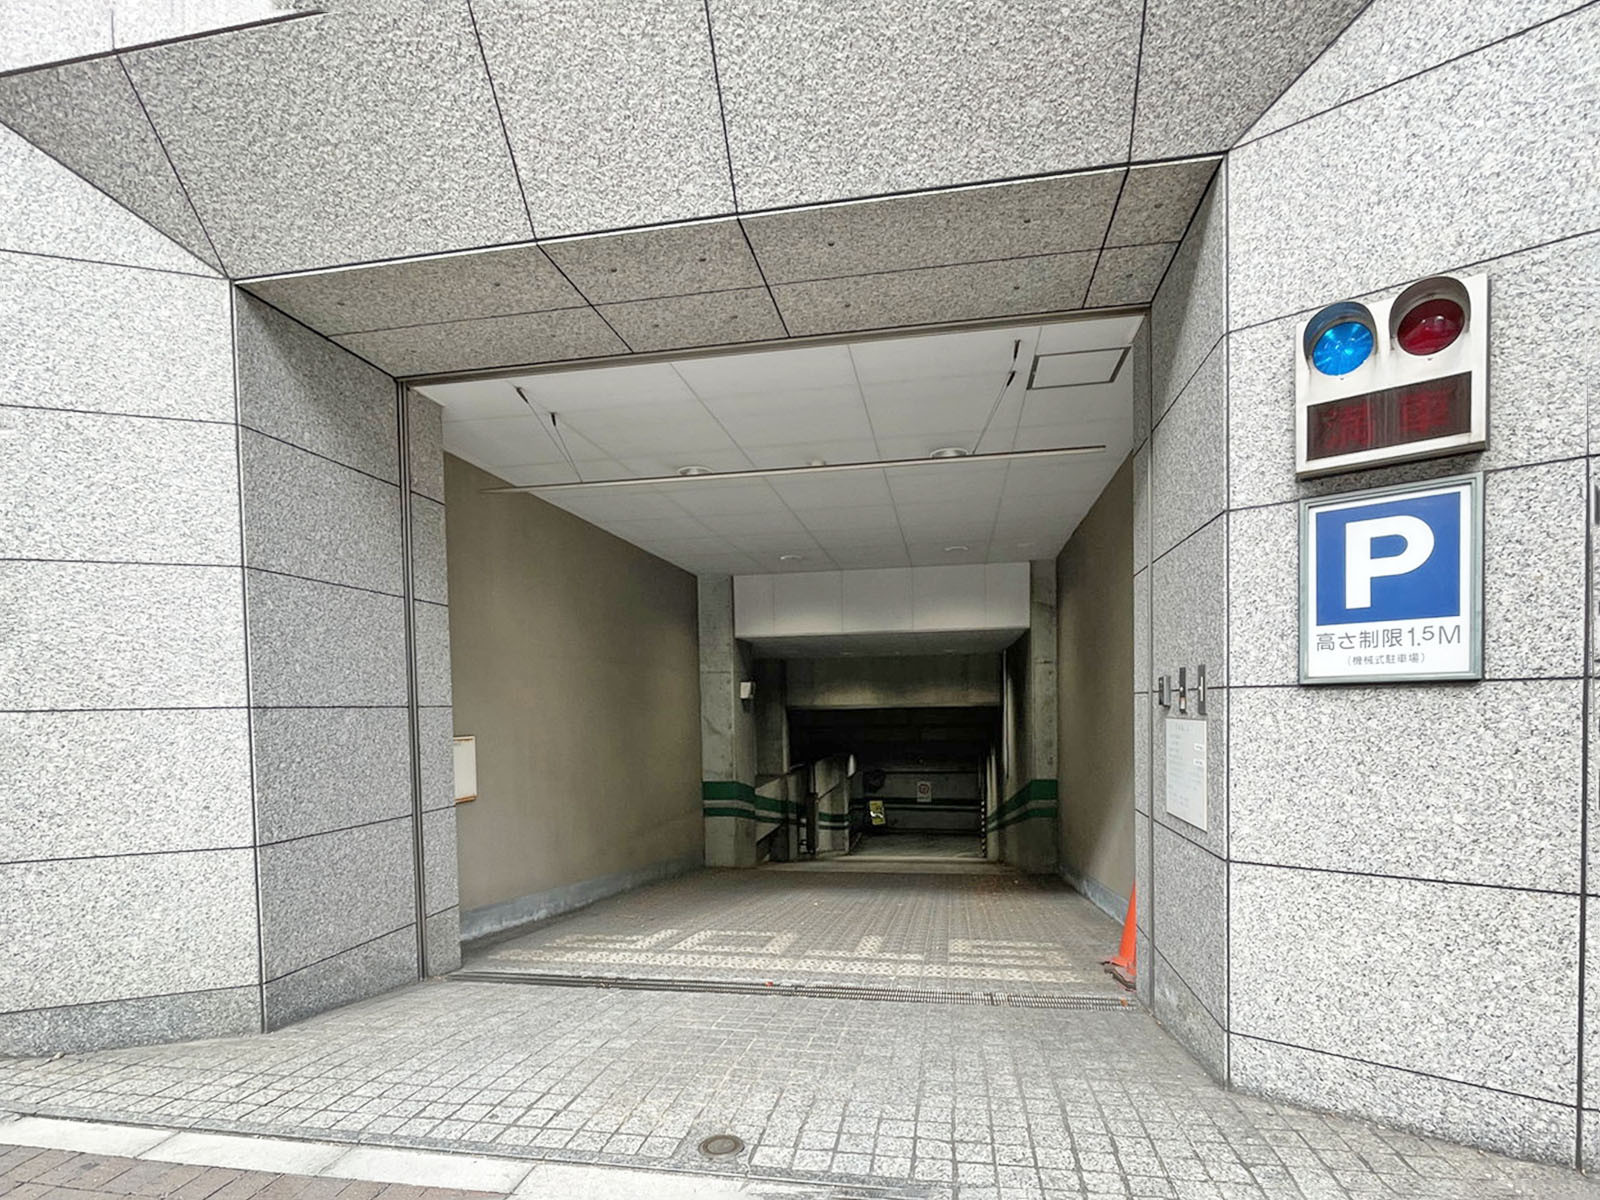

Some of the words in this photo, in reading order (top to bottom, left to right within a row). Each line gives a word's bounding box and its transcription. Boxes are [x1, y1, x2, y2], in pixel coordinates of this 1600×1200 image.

[1345, 515, 1435, 609] P
[1315, 624, 1461, 652] 高さ制限1.5M
